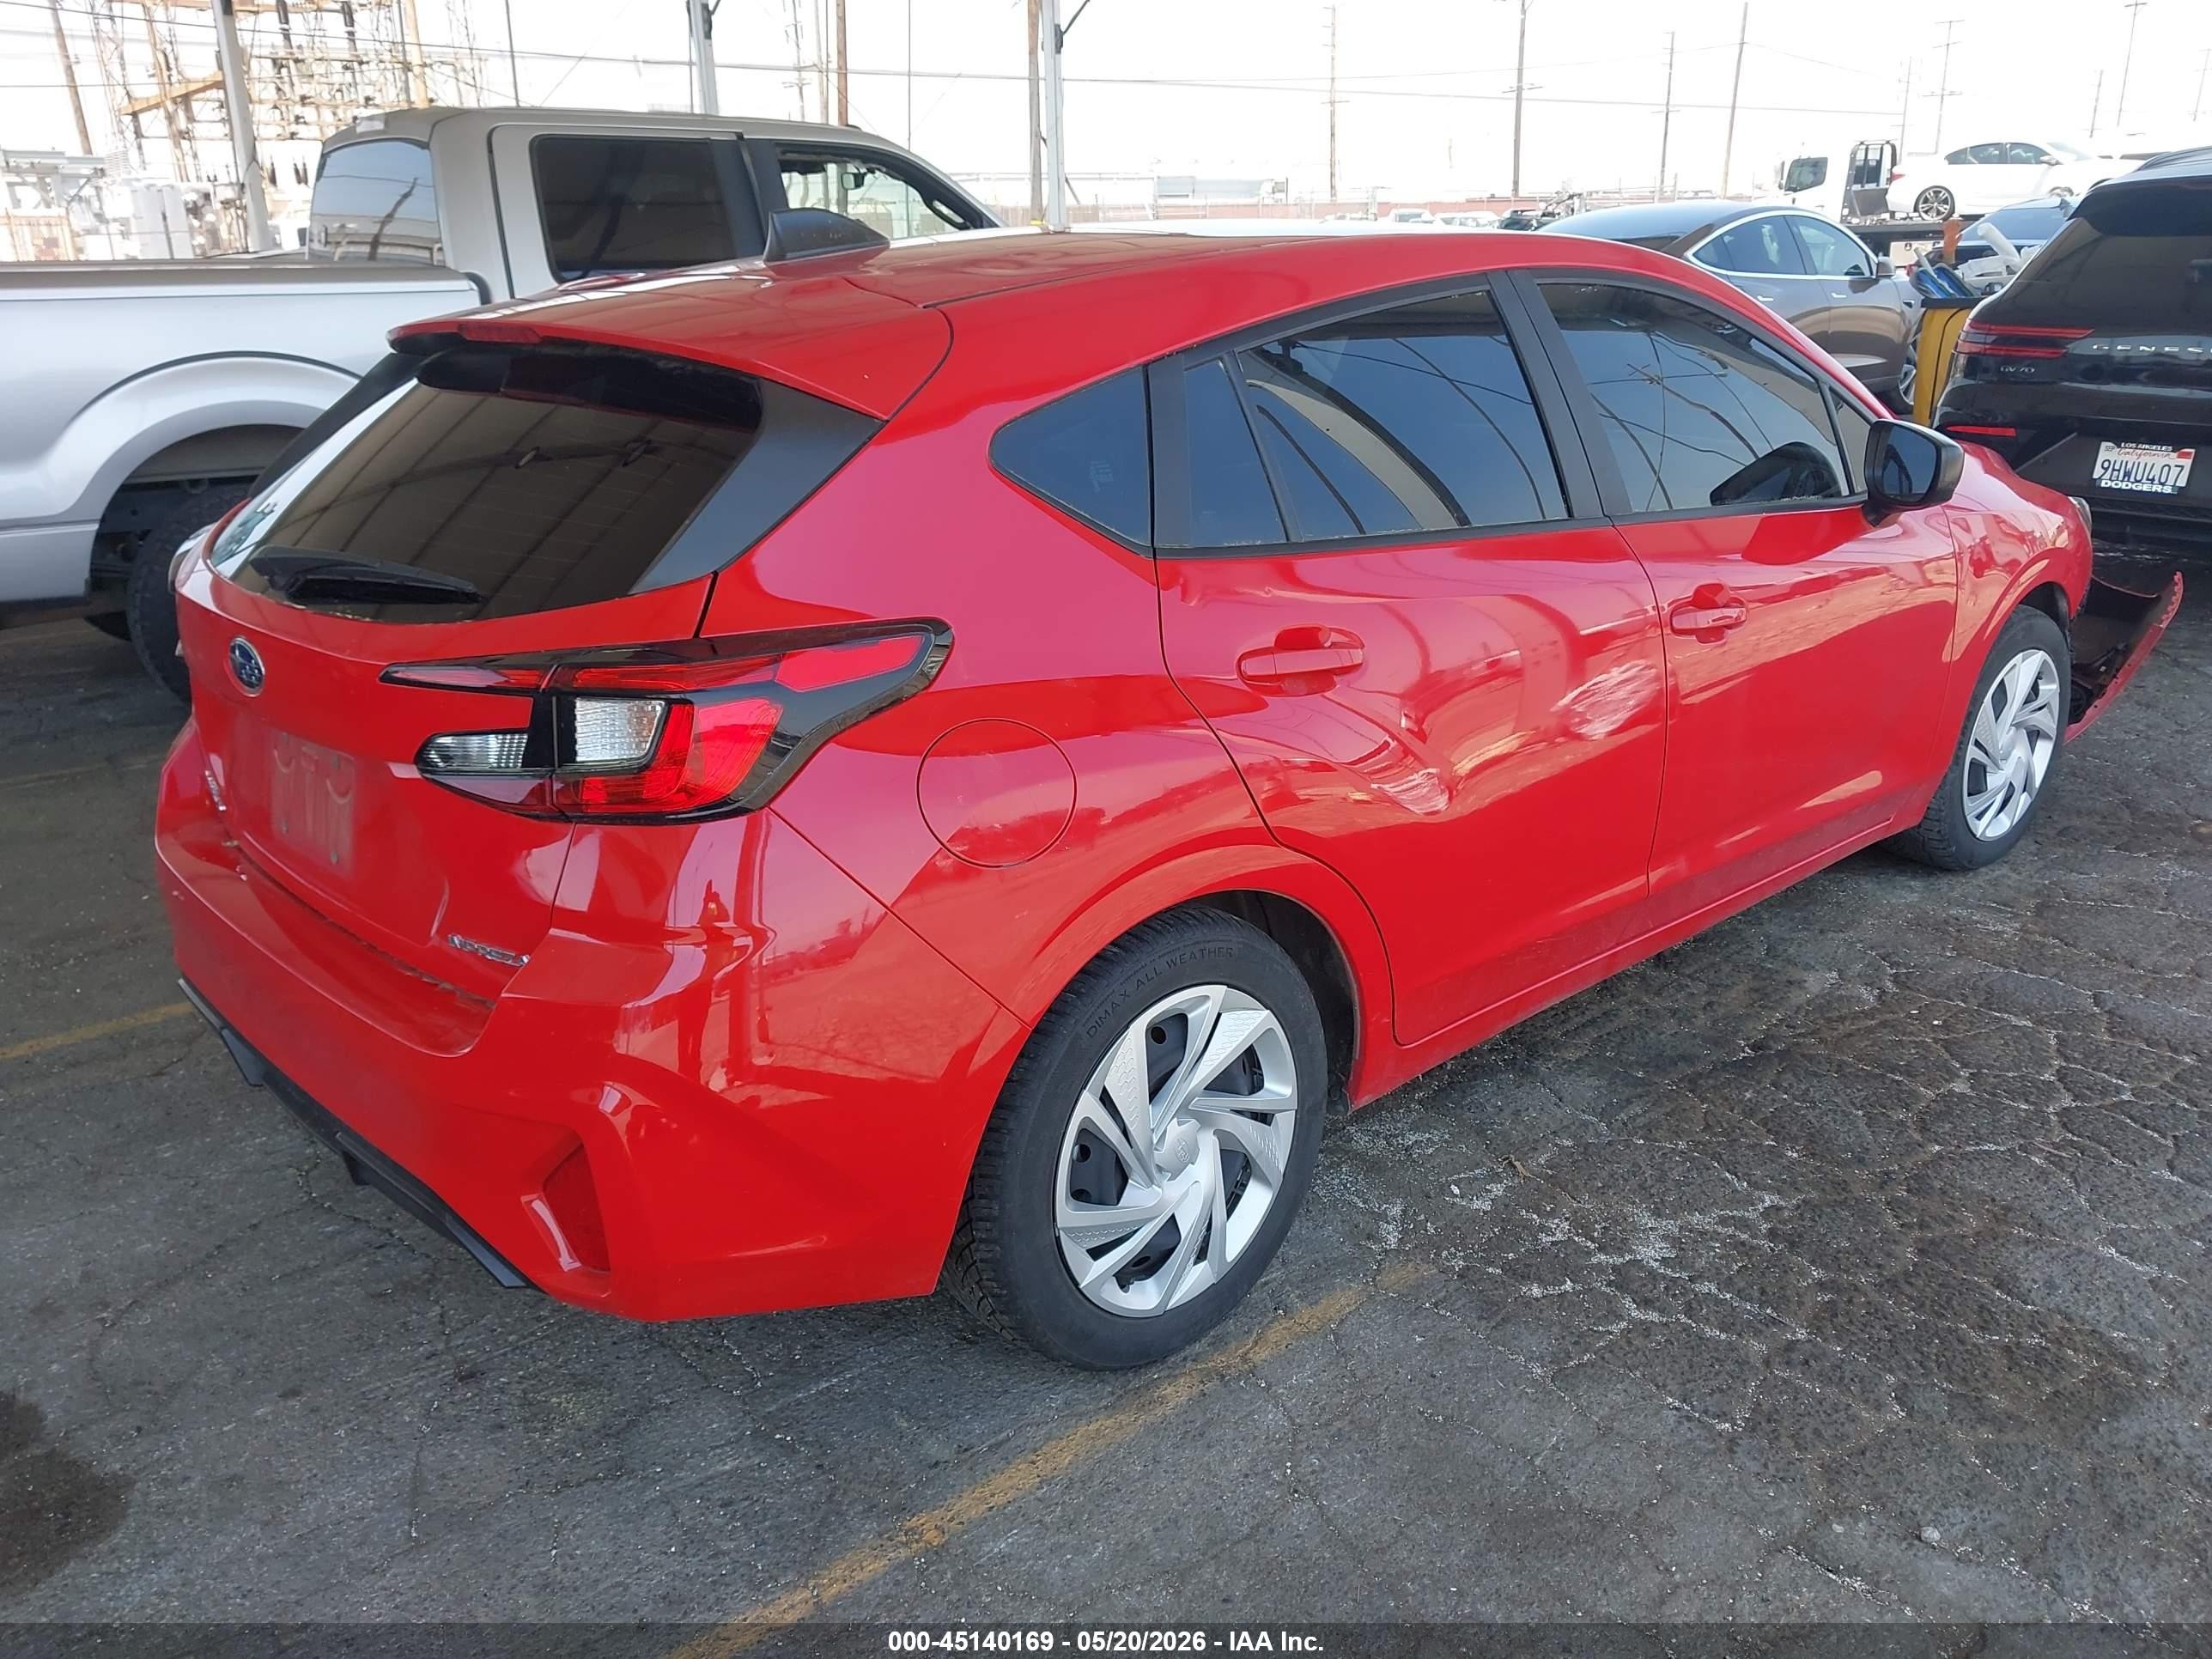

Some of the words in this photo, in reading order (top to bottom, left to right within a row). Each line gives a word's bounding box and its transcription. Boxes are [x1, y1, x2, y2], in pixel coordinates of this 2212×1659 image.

[2117, 448, 2177, 460] California
[2137, 443, 2173, 452] ANGELES
[2099, 459, 2185, 487] 9HWU407
[2100, 480, 2172, 494] DODGERS
[1086, 989, 1130, 1038] DIMAX
[1135, 966, 1163, 990] ALL
[1166, 947, 1234, 969] WEATHER
